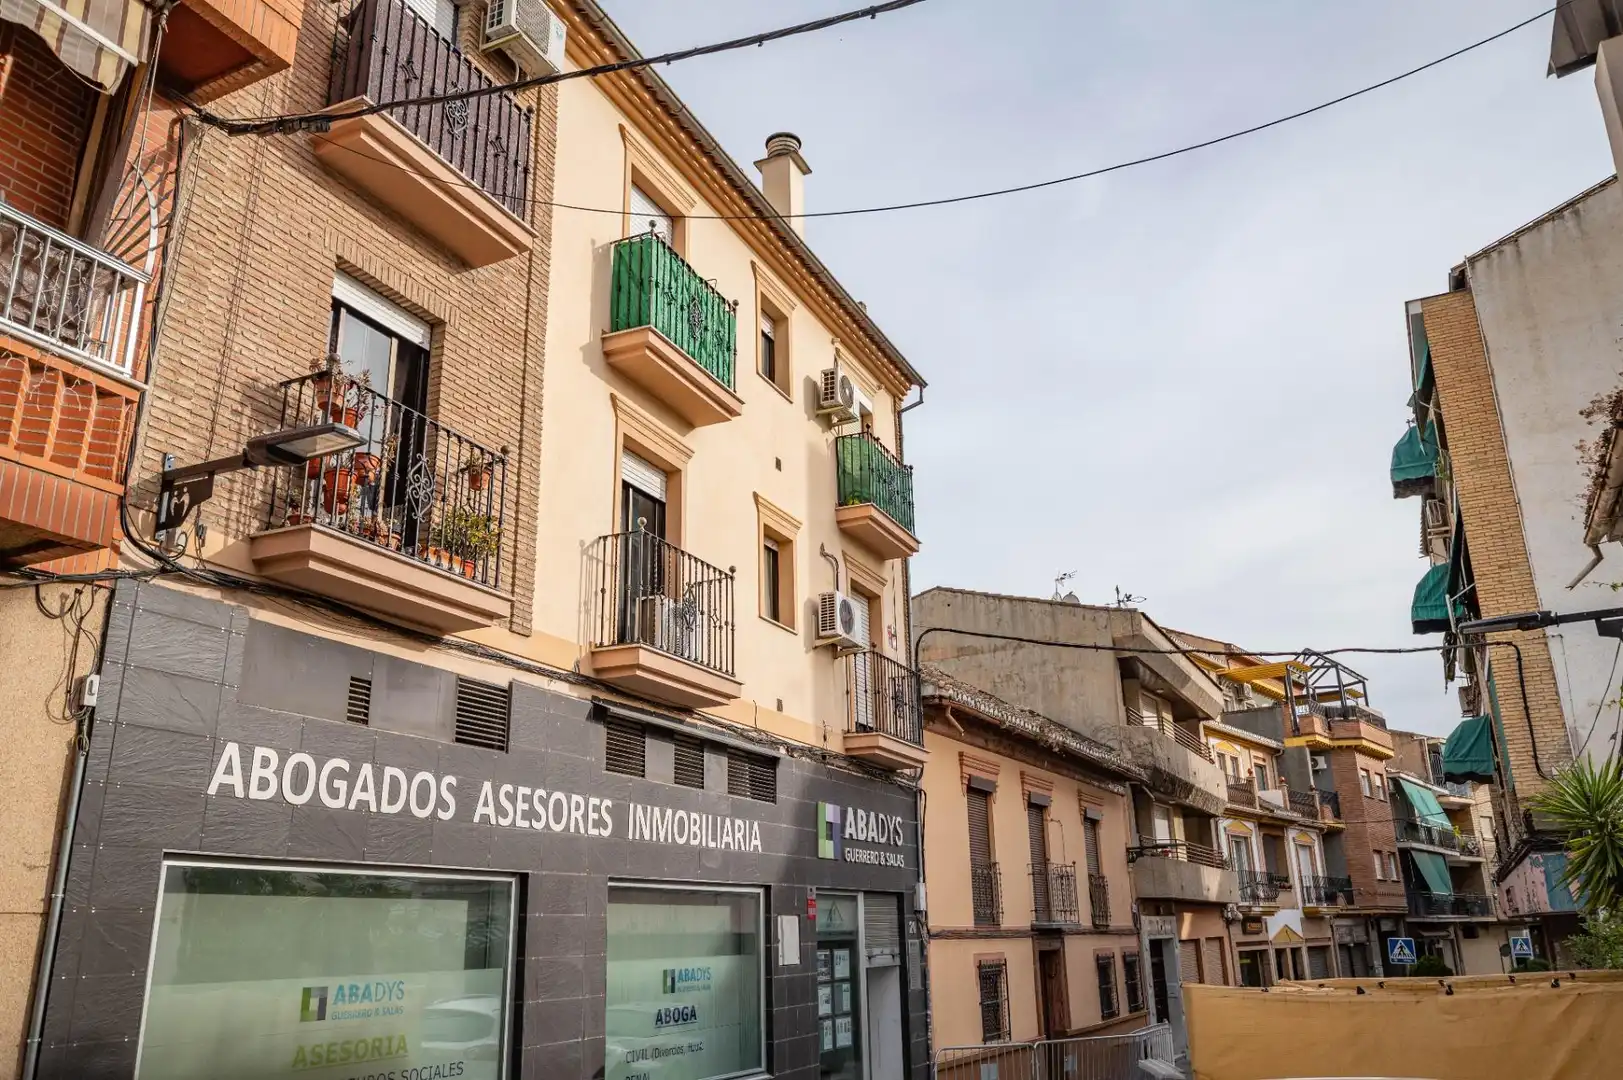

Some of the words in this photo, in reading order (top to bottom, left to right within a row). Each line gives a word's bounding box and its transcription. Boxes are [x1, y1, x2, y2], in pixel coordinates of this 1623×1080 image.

[206, 742, 458, 821] ABOGADOS
[472, 781, 613, 837] ASESORES
[627, 802, 763, 853] INMOBILIARIA
[843, 807, 904, 847] ABADYS
[845, 848, 880, 865] GUERRERO
[880, 851, 886, 866] &
[886, 853, 905, 869] SALAS
[676, 967, 711, 983] ABADYS
[331, 980, 405, 1005] ABADYS
[655, 1004, 698, 1026] ABOGA
[291, 1034, 409, 1069] ASESORIA
[401, 1061, 464, 1080] SOCIALES
